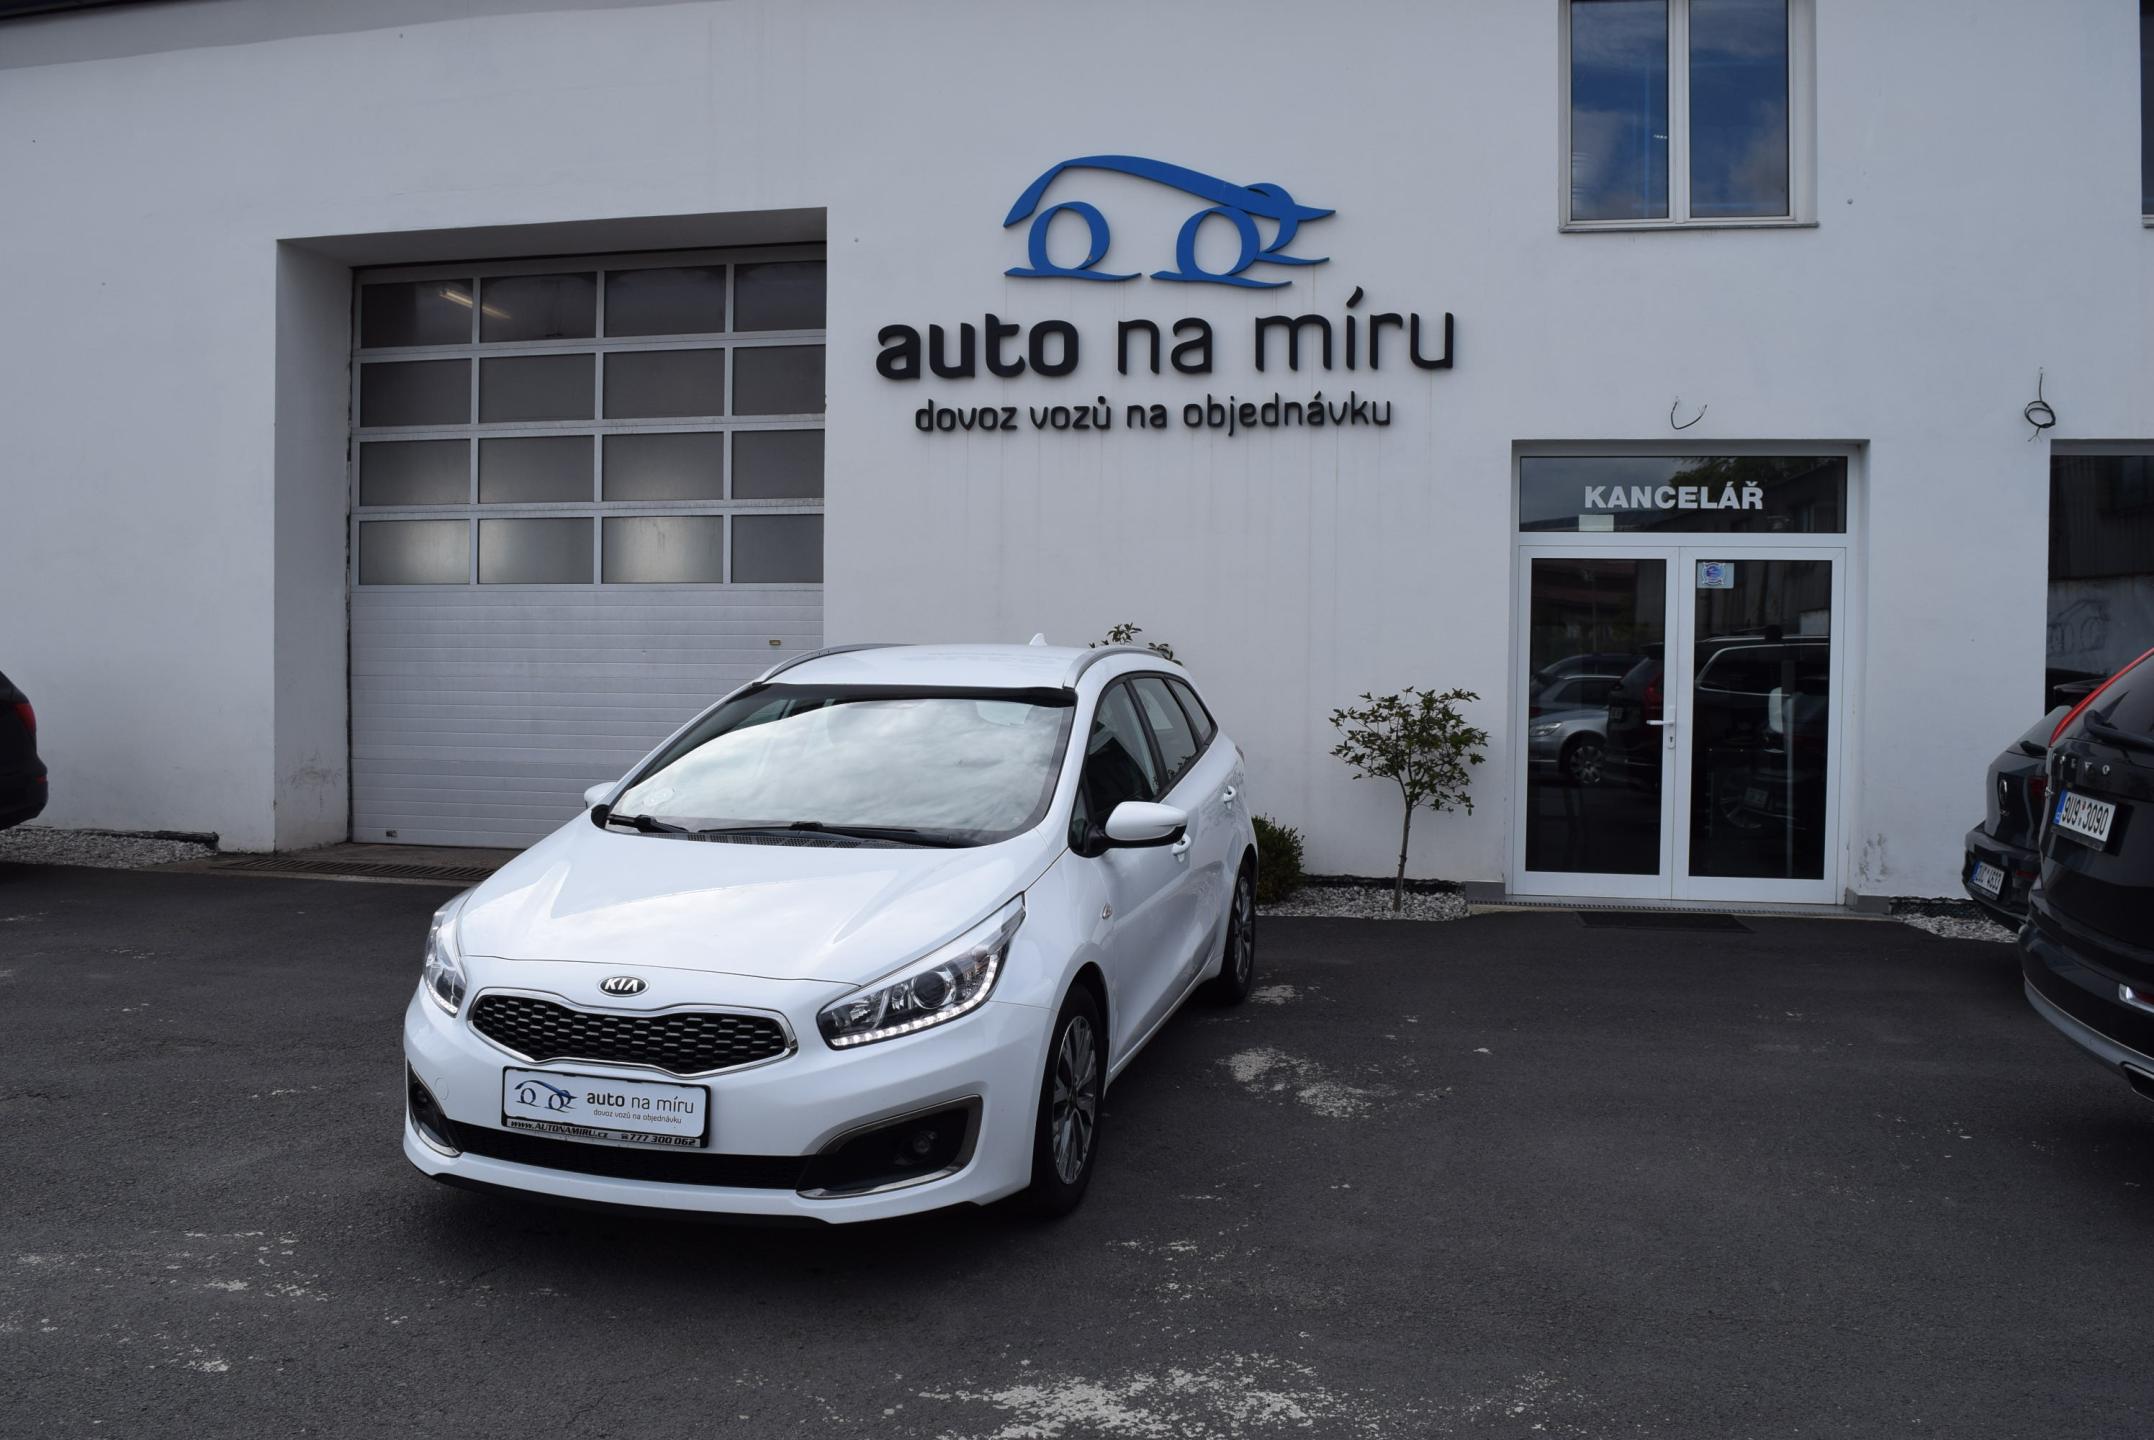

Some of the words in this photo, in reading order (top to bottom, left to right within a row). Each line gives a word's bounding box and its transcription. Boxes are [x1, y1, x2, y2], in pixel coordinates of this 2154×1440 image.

[875, 312, 1080, 380] auto
[1116, 316, 1214, 375] na
[1254, 286, 1455, 373] míru
[915, 399, 1018, 433] dovoz
[1029, 396, 1112, 431] vozů
[1126, 404, 1168, 429] na
[1183, 391, 1392, 437] objednávku
[1584, 481, 1764, 510] KANCELÁŘ
[2082, 802, 2110, 836] 3090
[604, 978, 638, 992] KIA
[586, 1092, 625, 1108] auto
[631, 1096, 650, 1110] na
[656, 1096, 694, 1114] míru
[593, 1109, 613, 1118] dovoz
[614, 1111, 631, 1119] vozů
[642, 1113, 682, 1124] objednávku
